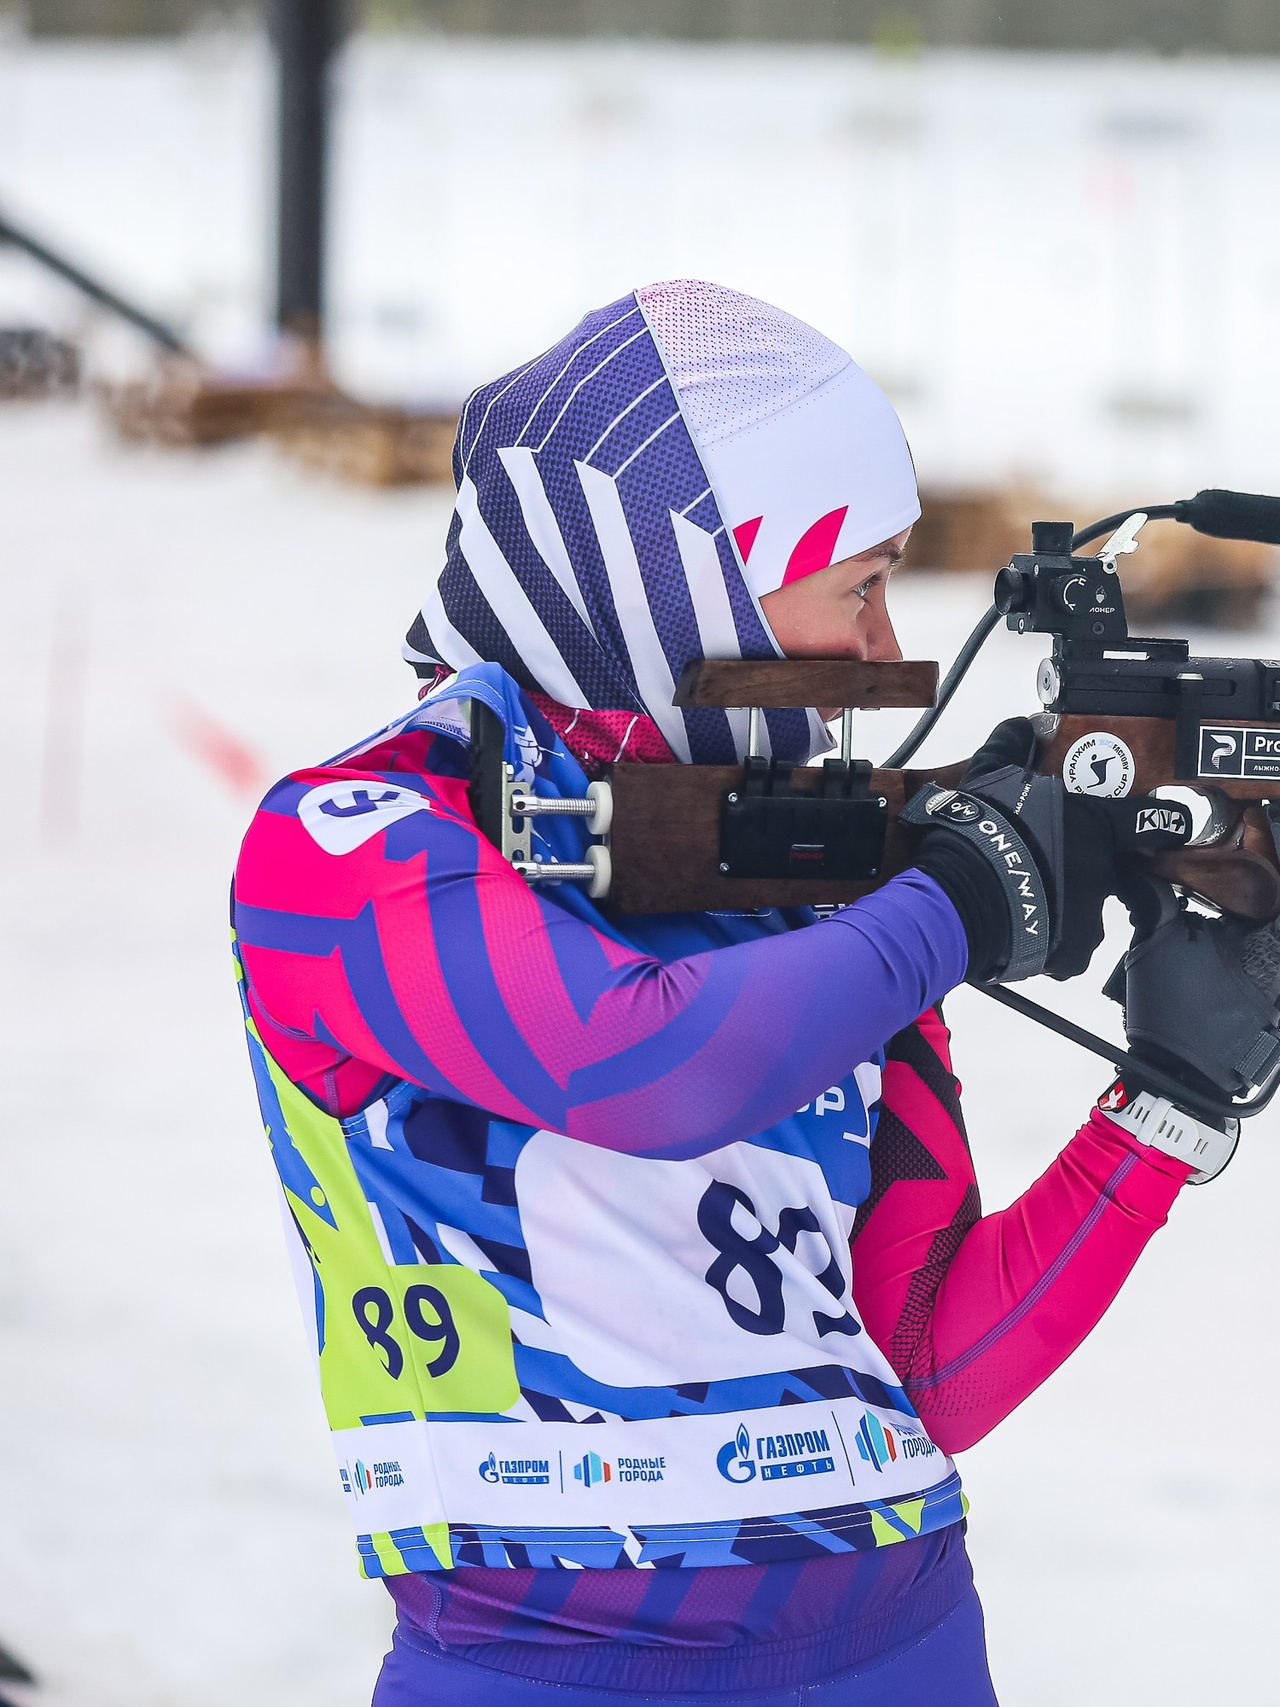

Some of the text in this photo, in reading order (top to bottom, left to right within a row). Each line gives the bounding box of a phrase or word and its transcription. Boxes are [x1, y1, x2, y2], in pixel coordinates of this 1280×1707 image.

[1069, 739, 1096, 783] УРАЛХИМ
[1112, 743, 1130, 770] FACTORY
[1113, 774, 1128, 796] CUP
[352, 1284, 460, 1380] 89
[757, 1429, 830, 1460] ГАЗПРОМ
[499, 1460, 549, 1473] ГАЗПРОМ
[617, 1457, 666, 1469] РОДНЫЕ
[765, 1461, 832, 1478] НЕФТЬ
[375, 1474, 404, 1488] ГОРОДА
[619, 1470, 664, 1482] ГОРОДА
